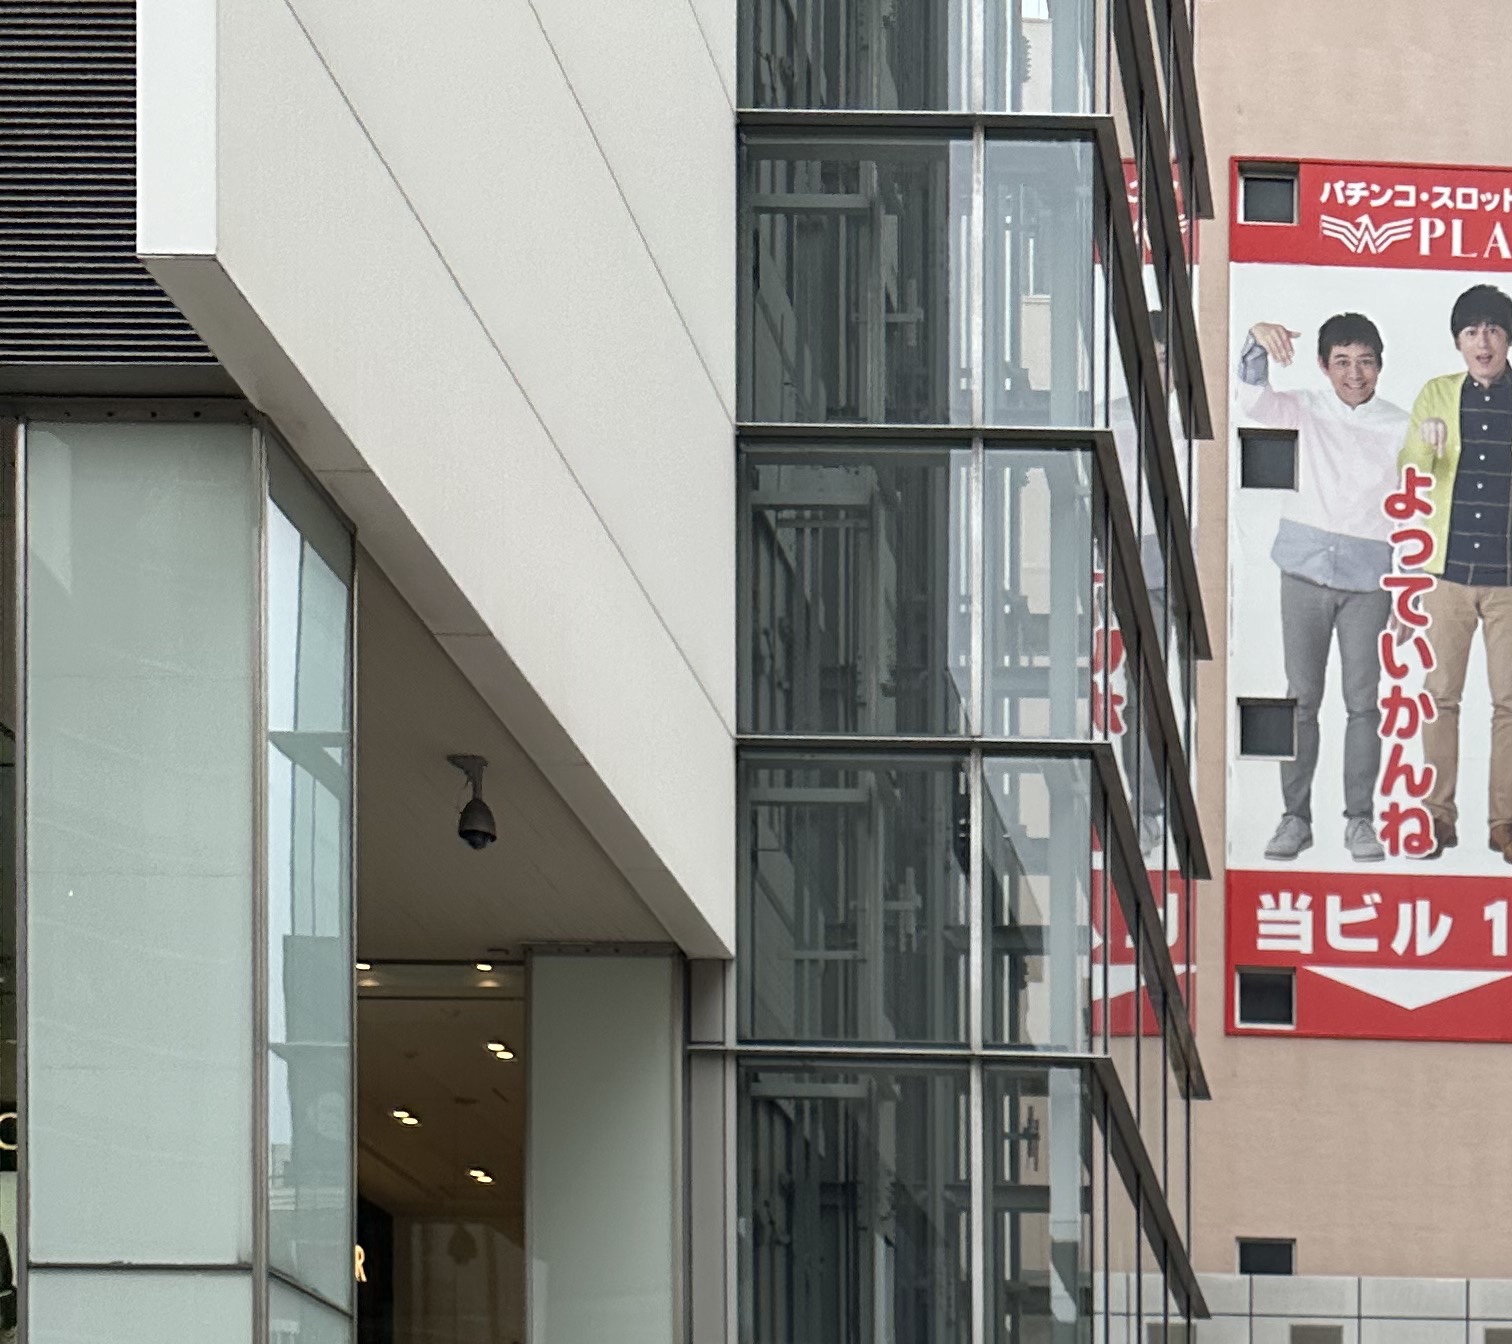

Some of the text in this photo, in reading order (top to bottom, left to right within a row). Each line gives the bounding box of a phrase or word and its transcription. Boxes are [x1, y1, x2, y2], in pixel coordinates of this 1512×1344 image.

[1379, 465, 1437, 857] よっていかんね
[1256, 891, 1453, 956] 当ビル
